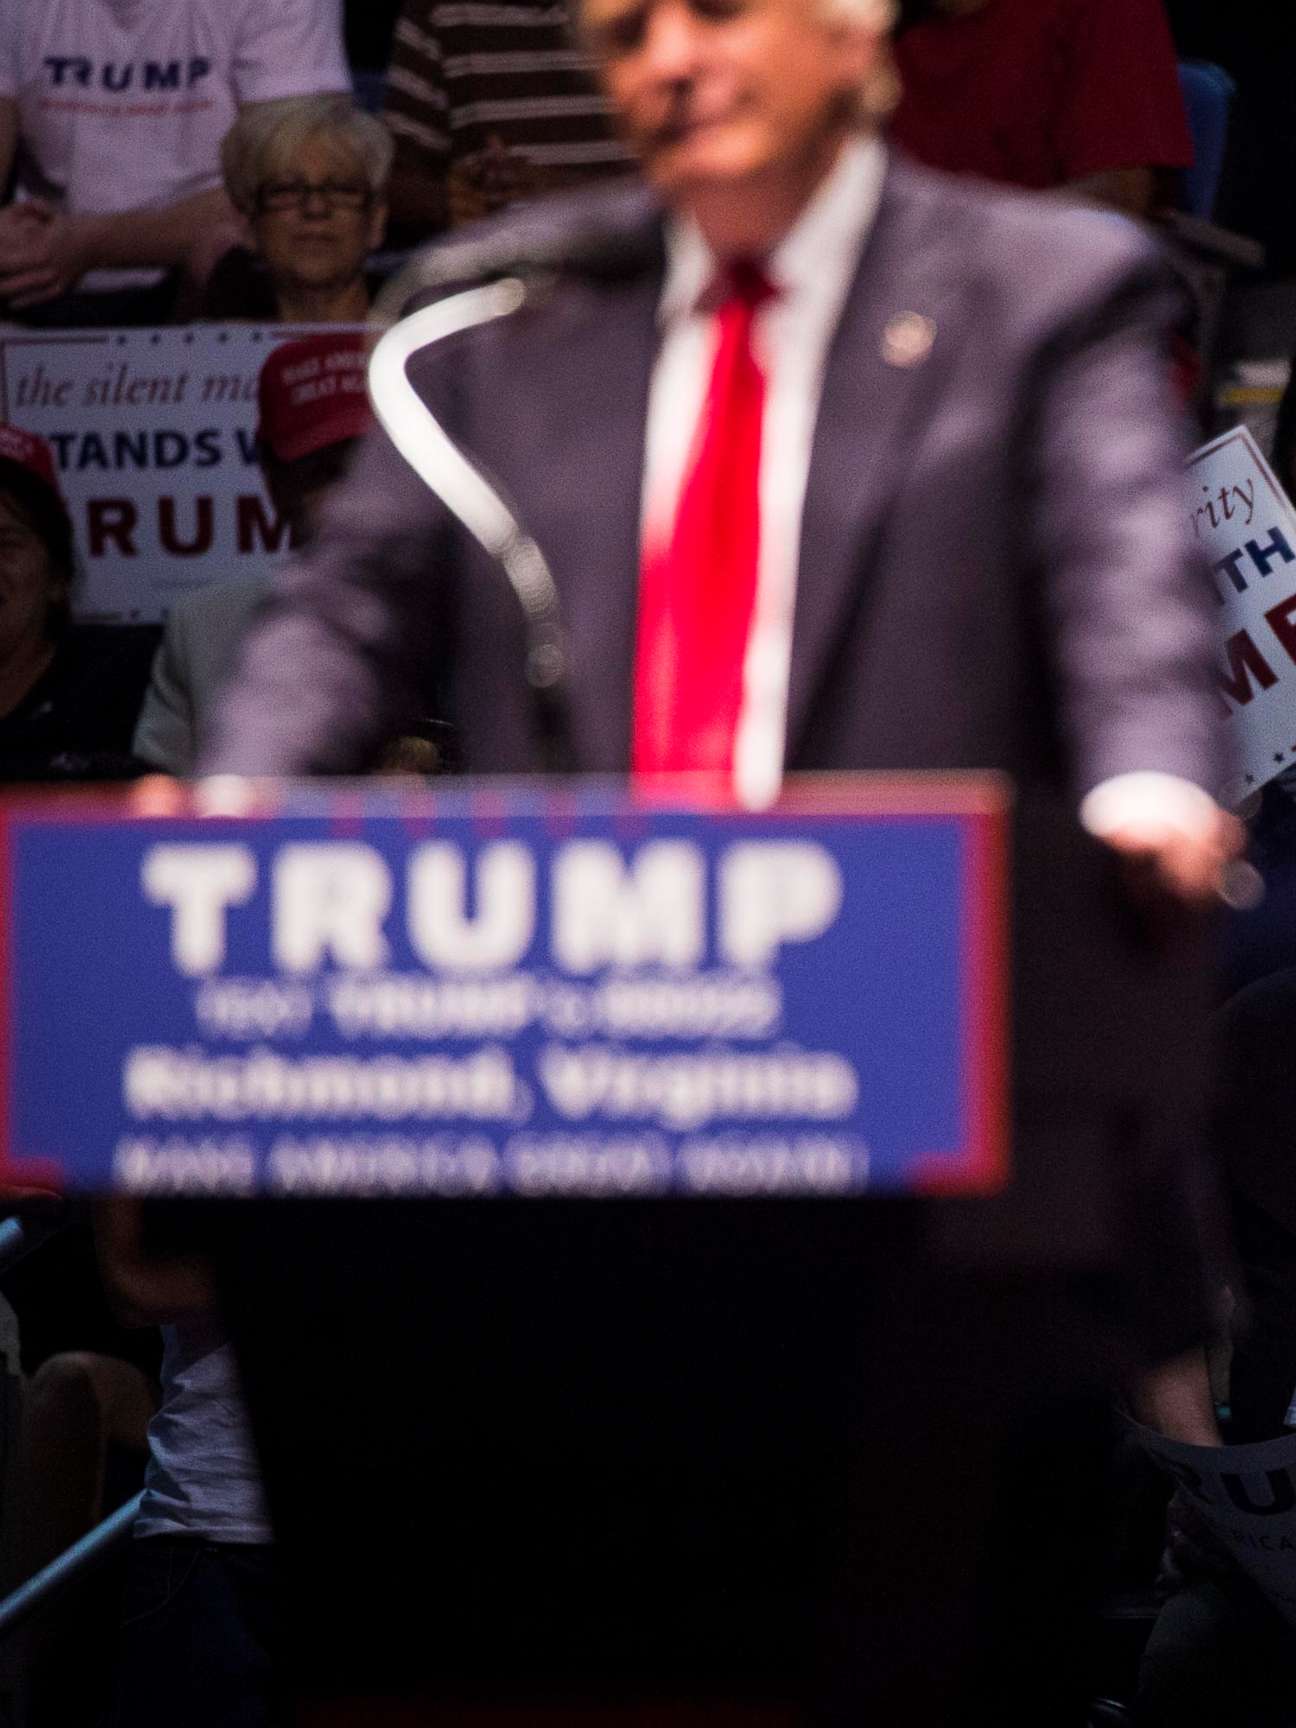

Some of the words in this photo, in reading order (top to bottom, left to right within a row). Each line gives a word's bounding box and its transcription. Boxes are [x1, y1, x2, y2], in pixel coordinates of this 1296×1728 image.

[44, 55, 212, 92] TRUMP
[15, 366, 74, 407] the
[86, 363, 191, 406] silent
[1215, 526, 1296, 593] TH
[141, 838, 844, 976] TRUMP
